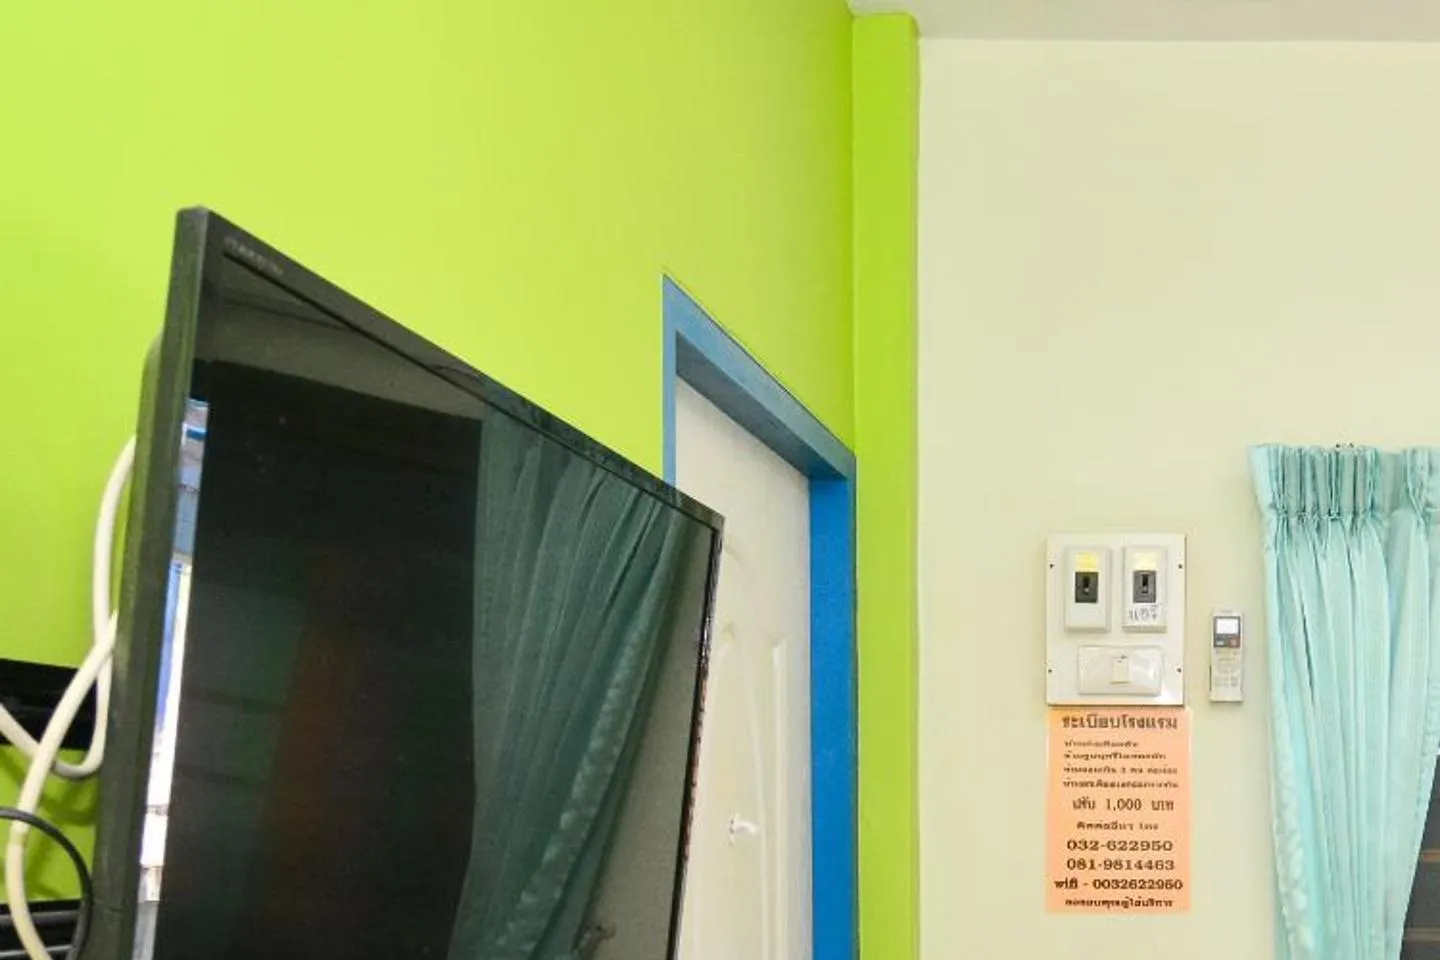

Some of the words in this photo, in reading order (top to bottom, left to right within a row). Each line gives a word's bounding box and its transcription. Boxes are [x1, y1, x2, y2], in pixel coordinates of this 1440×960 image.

[1061, 713, 1178, 729] ระเบียบโรงแรม
[1072, 796, 1097, 811] ปรับ
[1105, 798, 1143, 812] 1,000
[1151, 800, 1175, 811] บาท
[1066, 839, 1174, 852] 032-622950
[1066, 857, 1176, 871] 081-9814463
